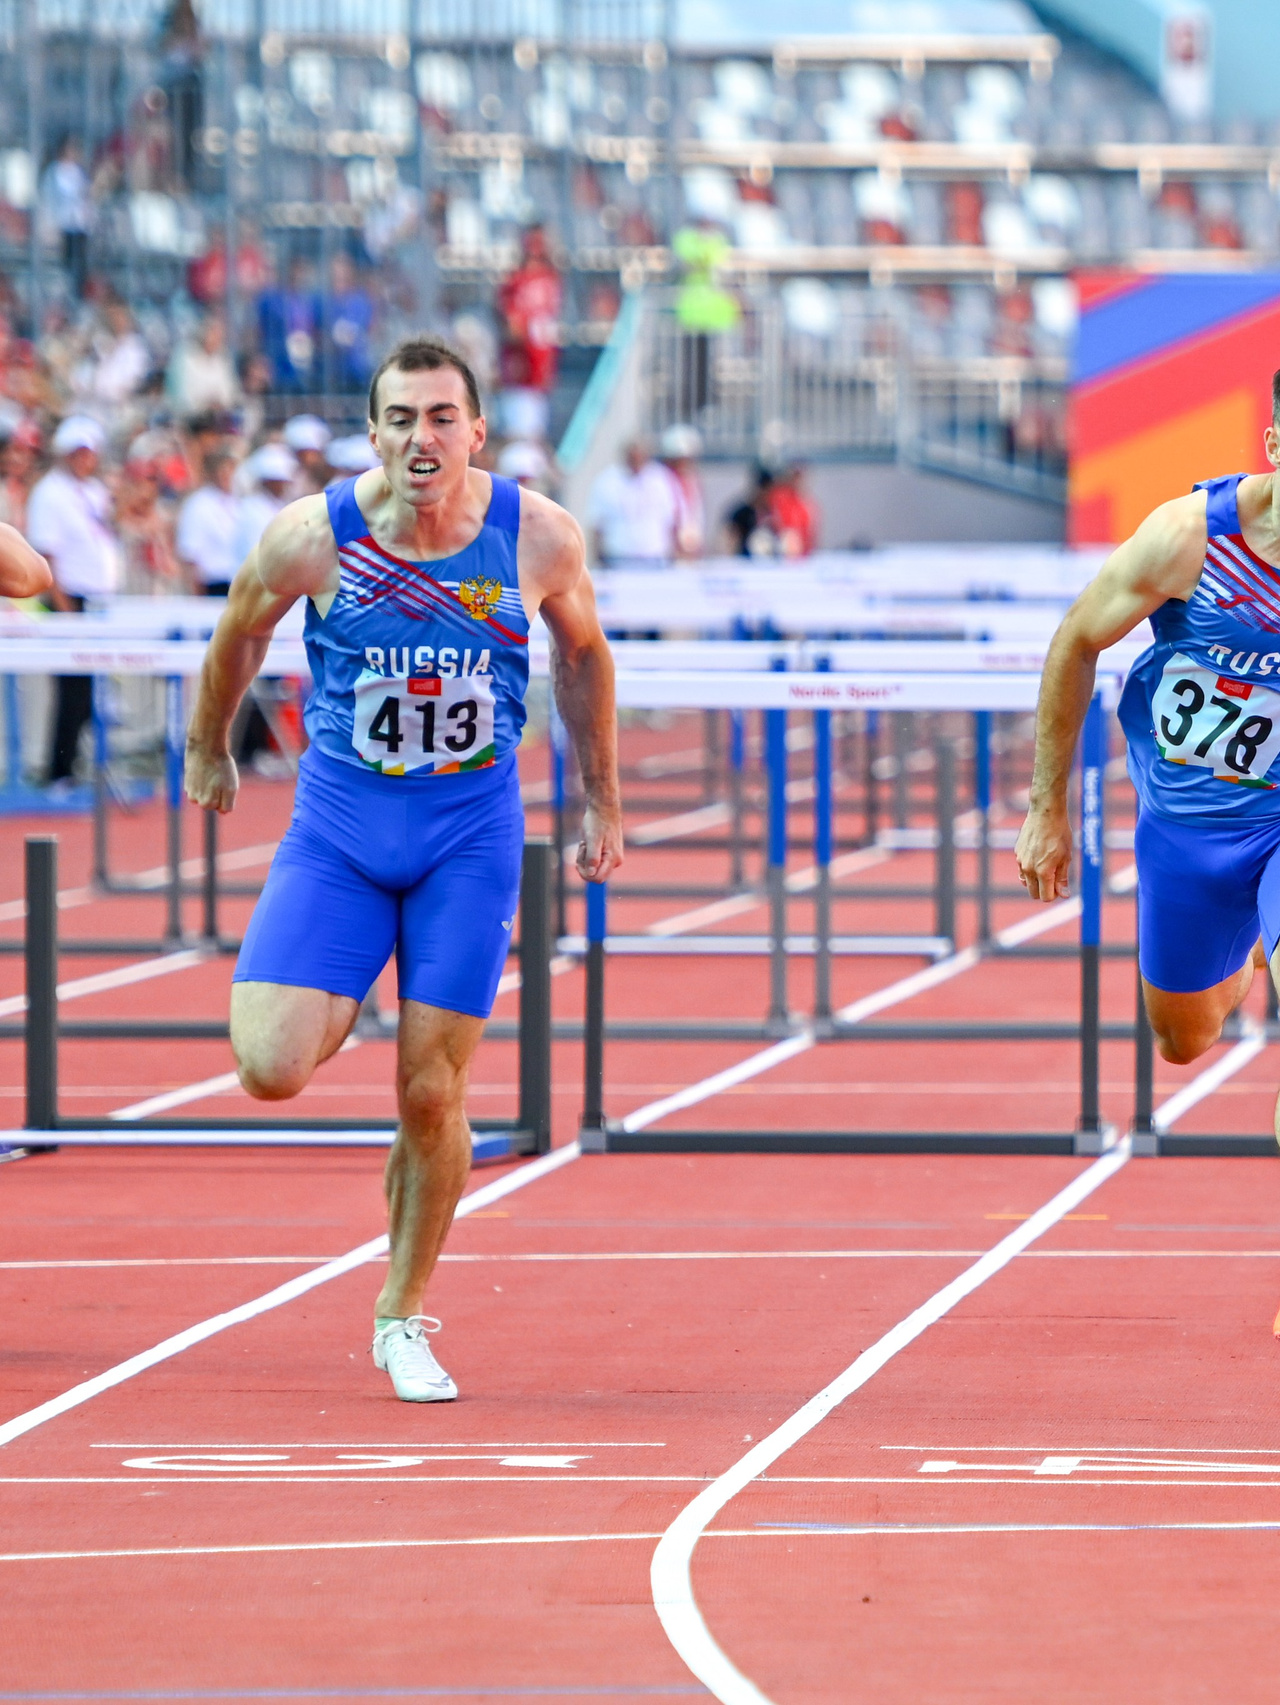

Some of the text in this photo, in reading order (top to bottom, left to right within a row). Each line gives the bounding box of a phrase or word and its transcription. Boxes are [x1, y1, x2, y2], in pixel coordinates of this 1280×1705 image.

[364, 645, 491, 679] RUSSIA
[368, 695, 478, 753] 413
[1161, 679, 1272, 774] 378
